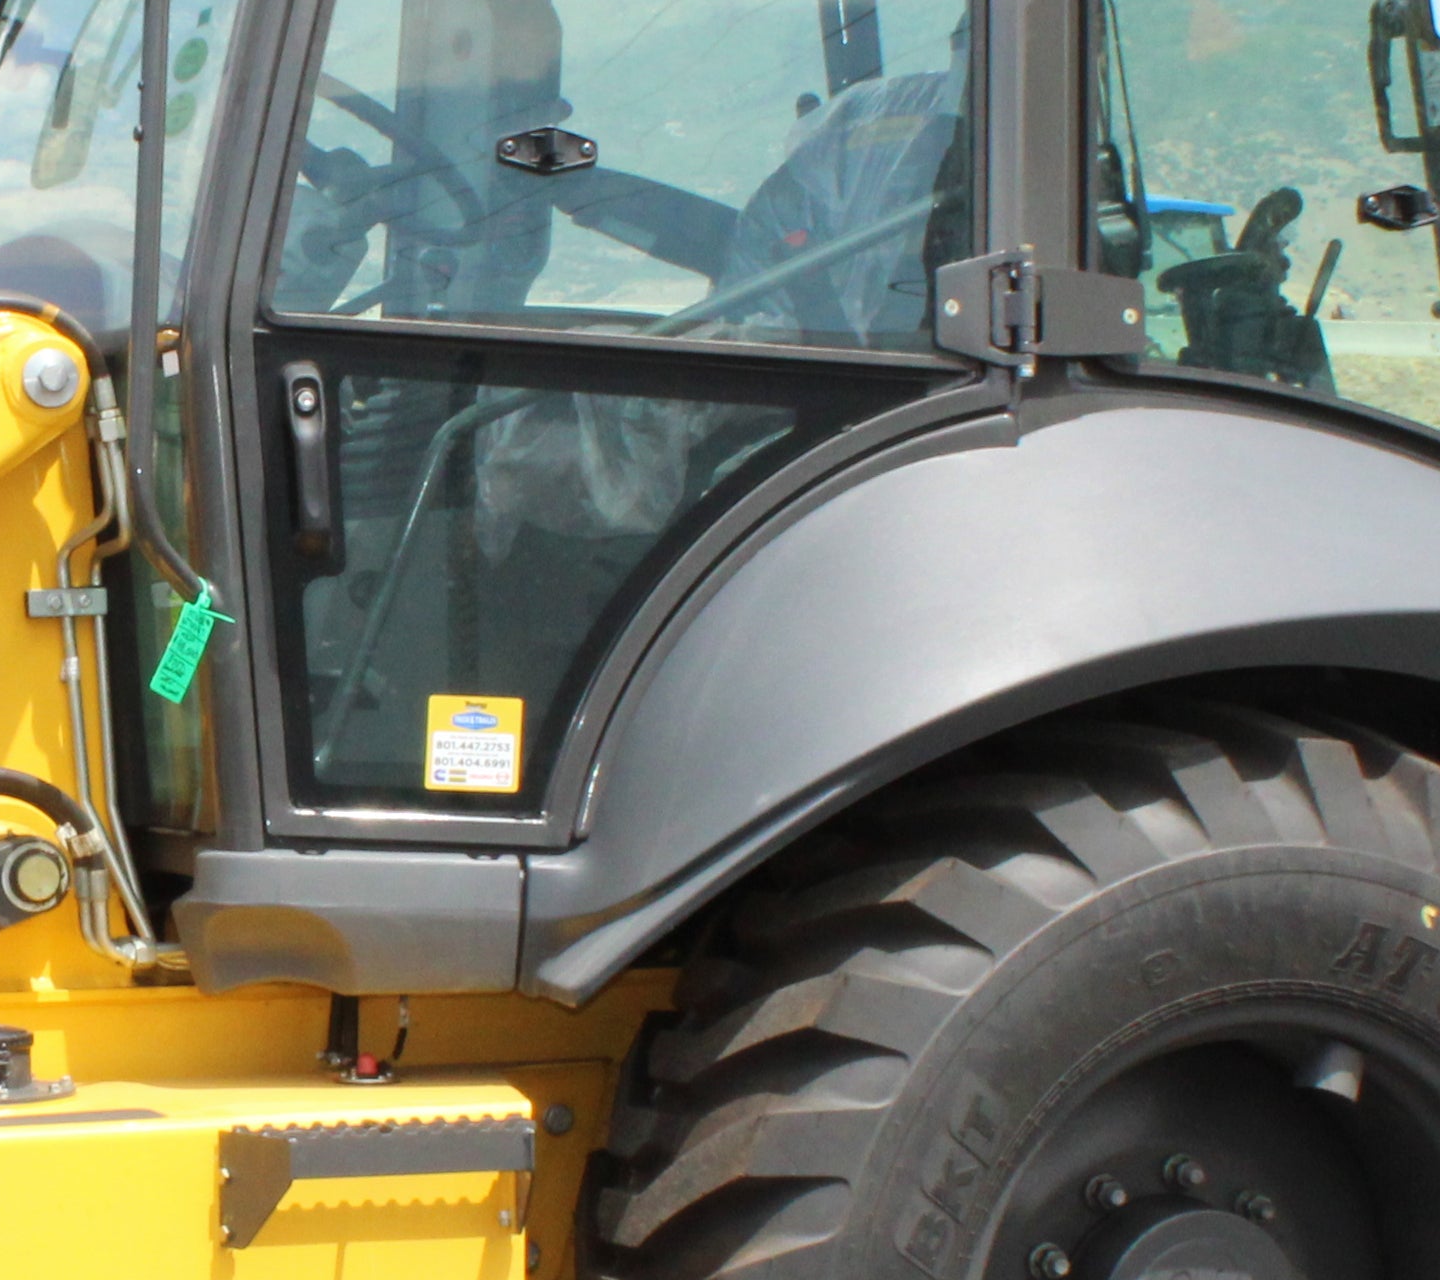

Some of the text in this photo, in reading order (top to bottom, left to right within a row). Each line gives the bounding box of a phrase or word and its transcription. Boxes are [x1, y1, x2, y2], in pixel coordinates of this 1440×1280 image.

[435, 740, 511, 752] 801.447.2753
[1332, 920, 1440, 986] AT
[900, 1082, 1000, 1278] BKT
